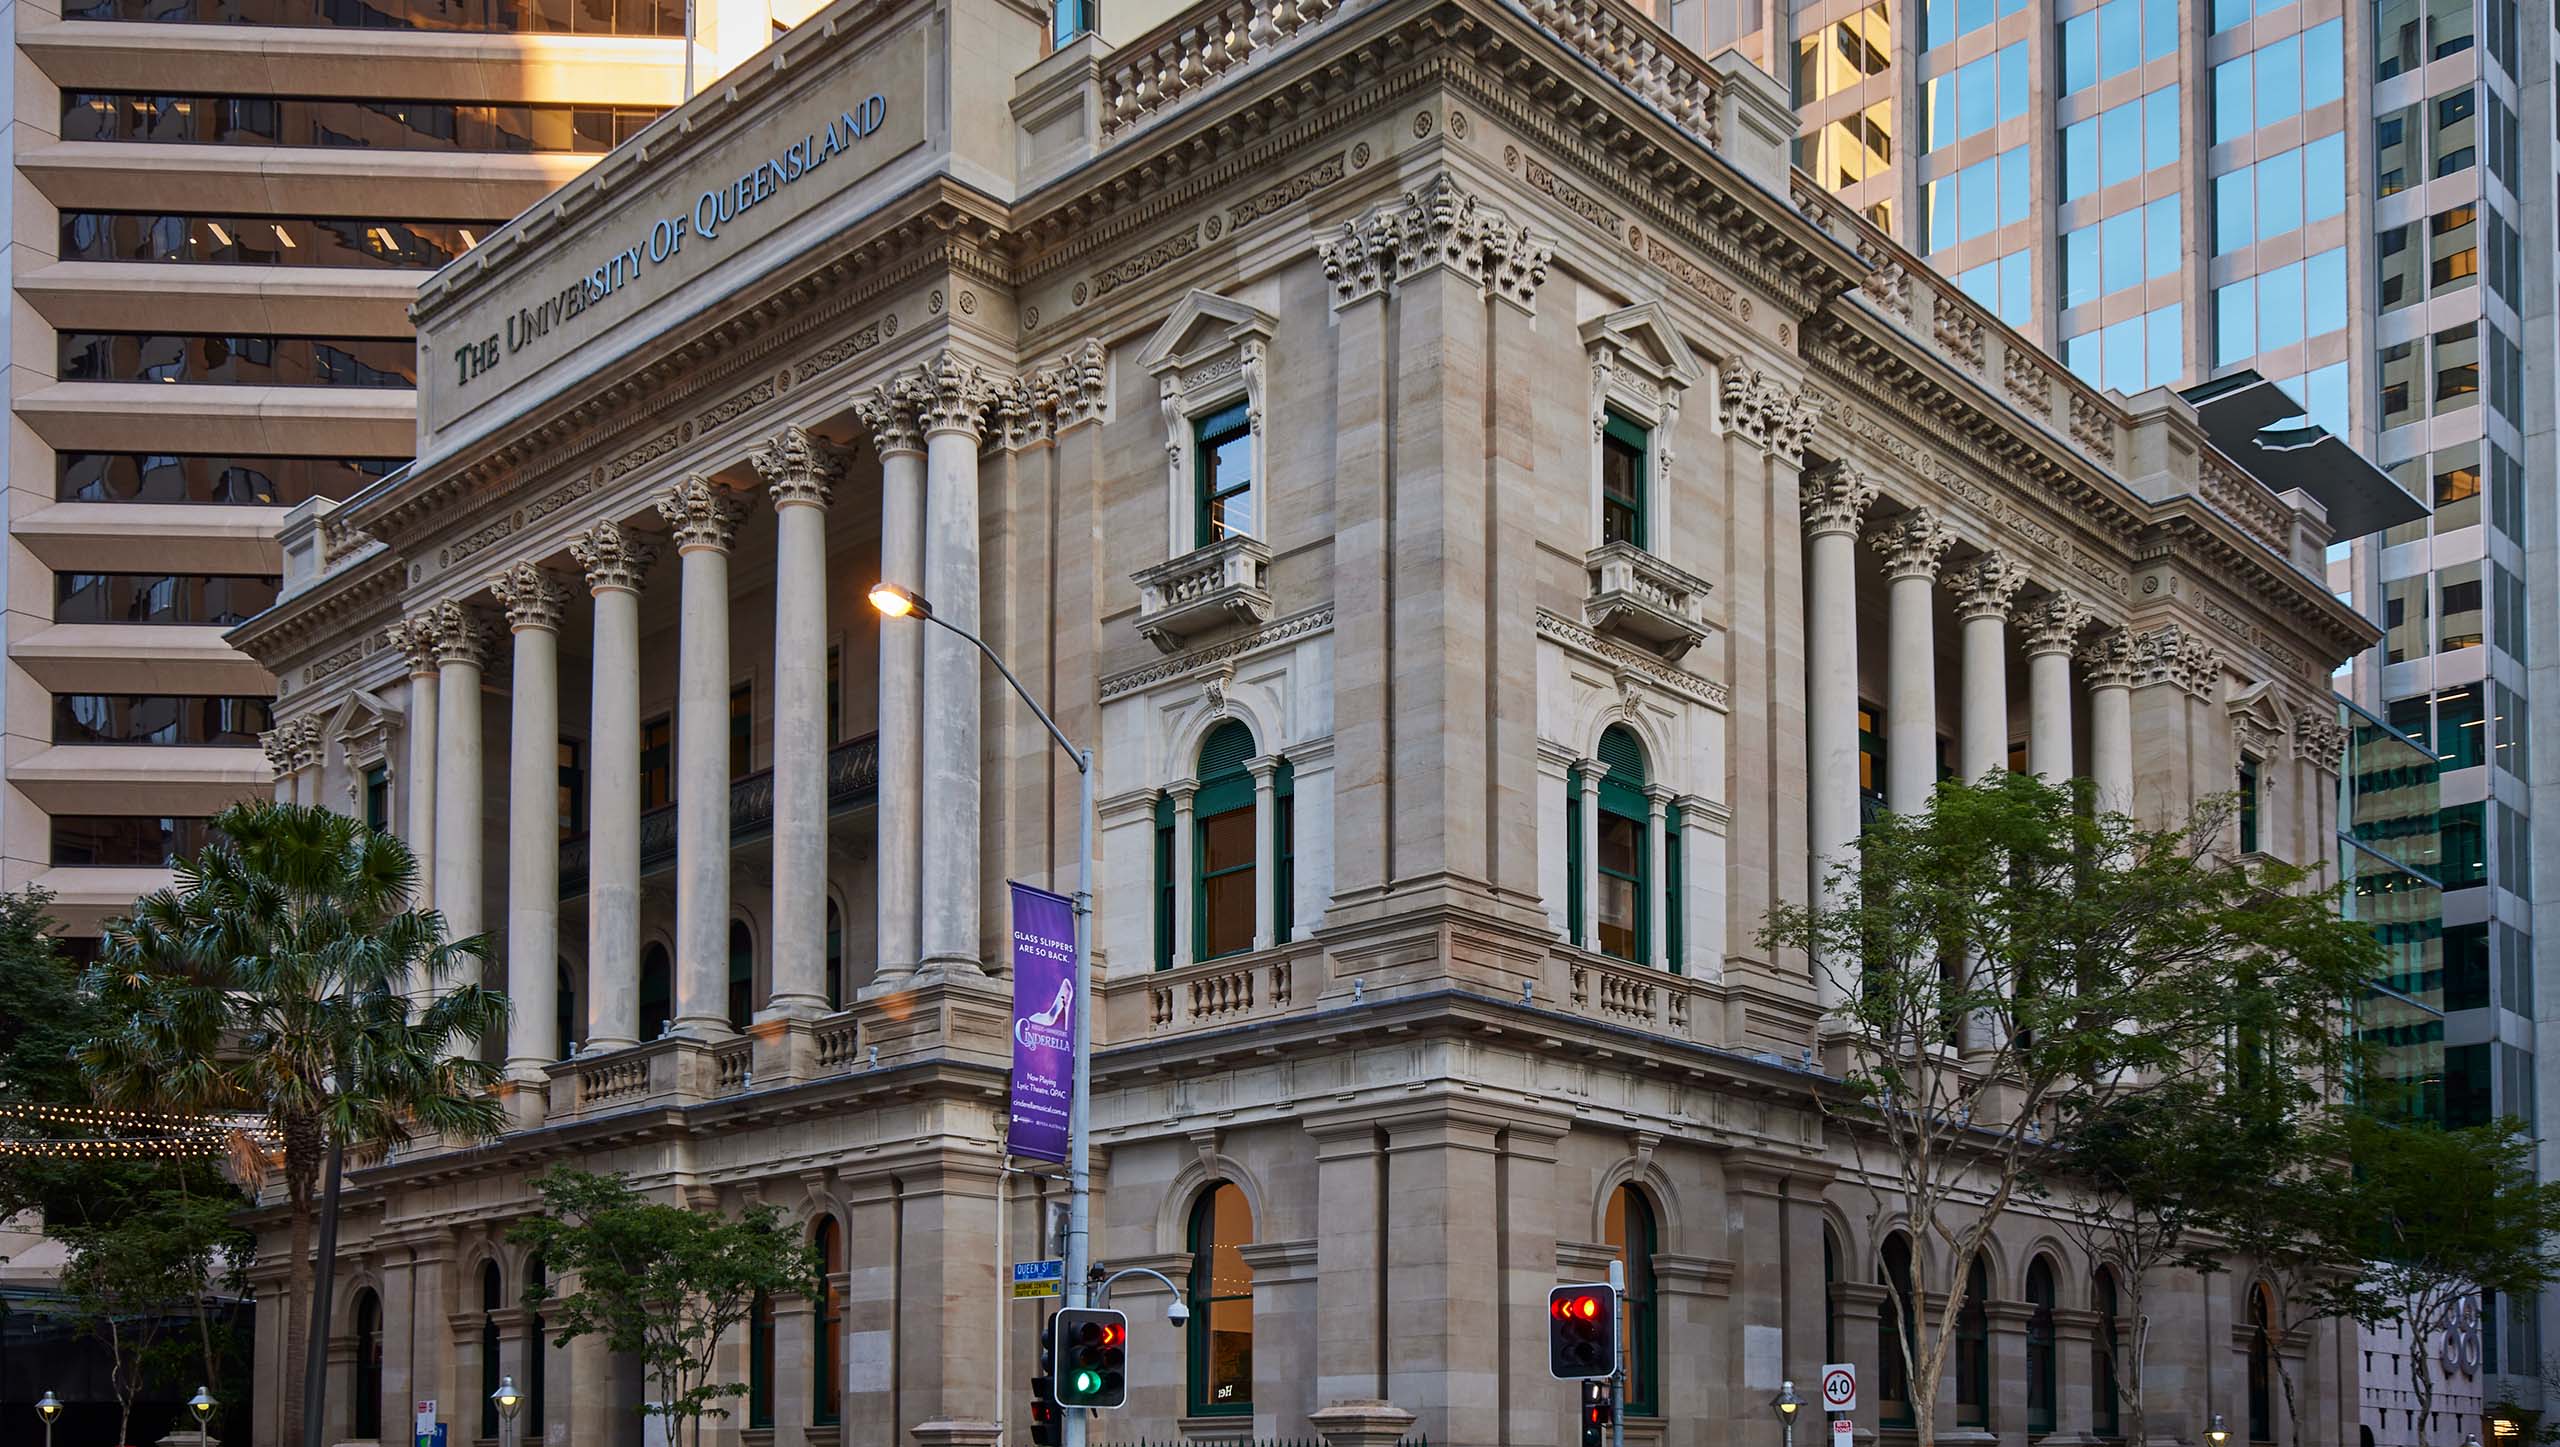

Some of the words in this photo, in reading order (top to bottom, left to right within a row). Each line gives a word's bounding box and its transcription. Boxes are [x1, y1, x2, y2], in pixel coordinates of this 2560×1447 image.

[455, 331, 500, 387] THE
[506, 241, 646, 354] UNIVERSITY
[694, 92, 887, 240] QUEENSLAND
[1014, 931, 1038, 944] GLASS
[1040, 937, 1073, 953] SLIPPERS
[1019, 944, 1034, 954] ARE
[1035, 947, 1047, 957] SO
[1048, 950, 1070, 963] BACK.
[1015, 1017, 1070, 1052] CINDERELLA
[1027, 1072, 1039, 1082] Now
[1039, 1074, 1057, 1088] Playing
[1016, 1080, 1030, 1091] Lyric
[1049, 1088, 1067, 1100] QPAC
[1018, 1263, 1039, 1274] QUEEN
[1828, 1379, 1850, 1395] 40
